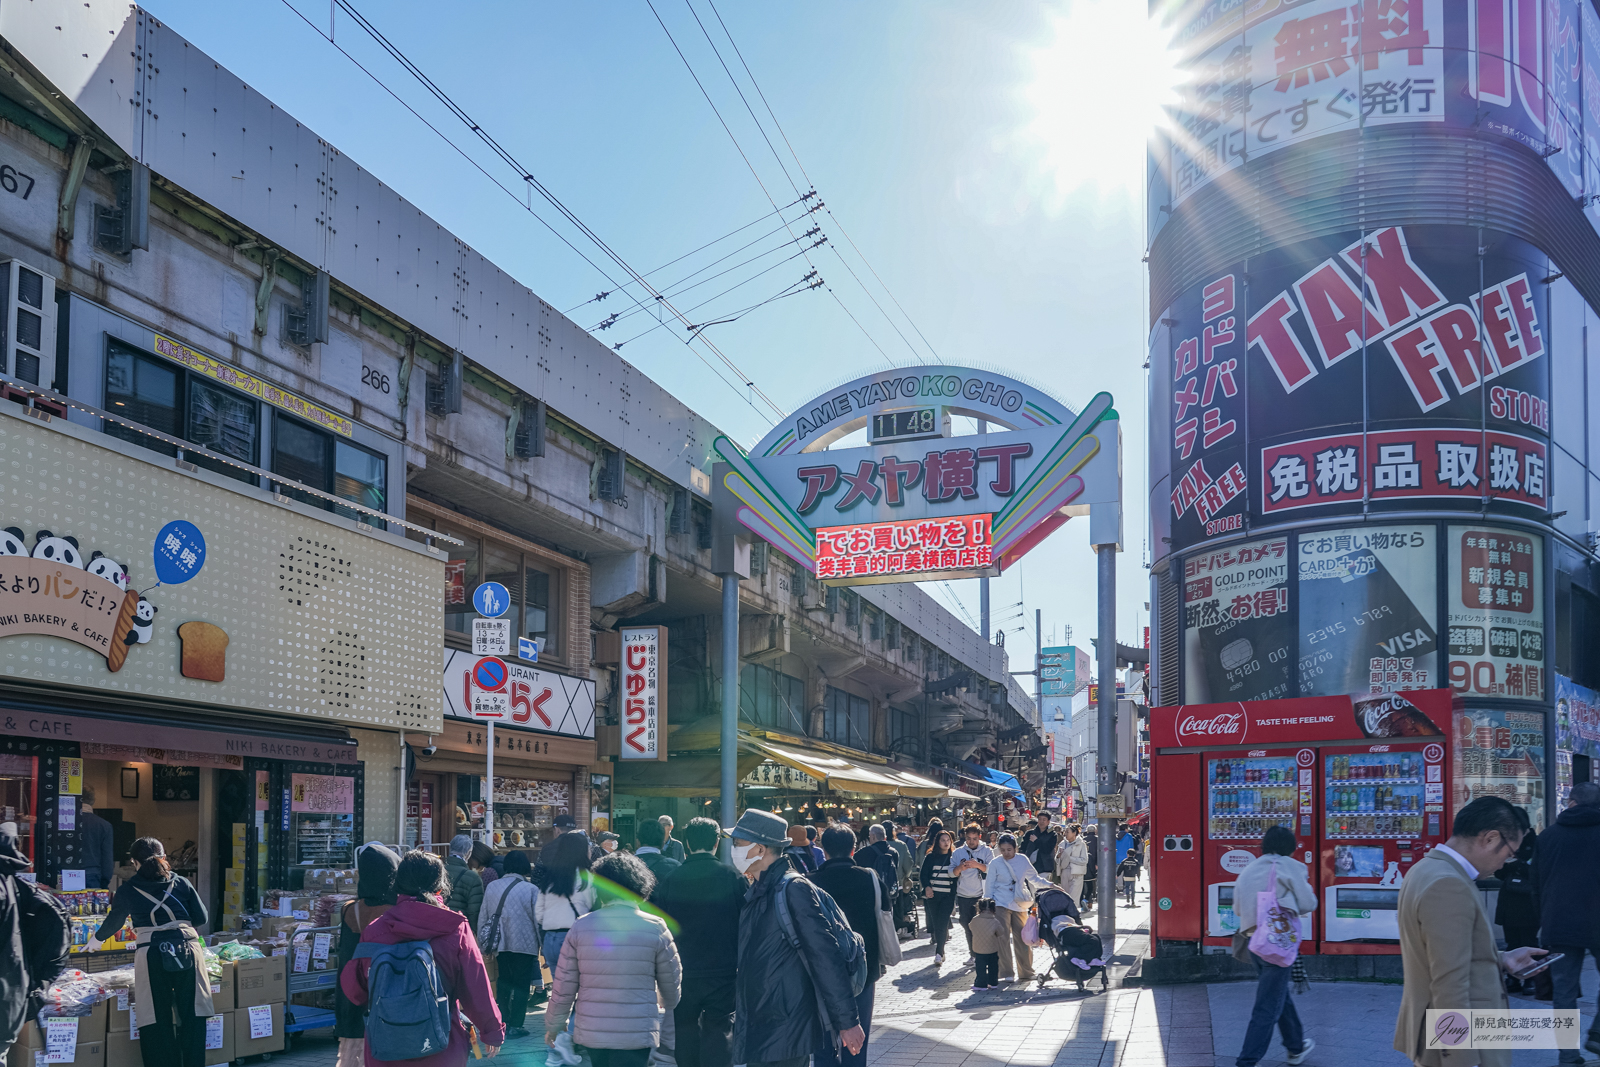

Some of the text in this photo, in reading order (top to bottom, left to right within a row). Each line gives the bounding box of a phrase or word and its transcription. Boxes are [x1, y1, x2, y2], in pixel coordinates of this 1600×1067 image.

[1273, 0, 1430, 93] 無料
[1248, 226, 1449, 394] TAX
[1383, 272, 1546, 413] FREE
[1201, 274, 1238, 449] ヨドバシ
[361, 364, 391, 394] 266
[796, 374, 1024, 440] AMEYAYOKOCHO
[1174, 337, 1199, 460] カメラ
[1489, 386, 1549, 432] STORE
[906, 409, 934, 433] 48
[796, 442, 1033, 514] アメヤ横丁
[1269, 440, 1546, 502] 免税品取扱店
[1171, 459, 1214, 519] TAX
[1194, 462, 1247, 526] FREE
[1206, 514, 1243, 536] STORE
[1185, 531, 1425, 578] ヨドバシカメラ でお買い物なら
[1466, 536, 1532, 555] 年会費・入会金
[1488, 550, 1511, 565] 無料
[1214, 571, 1245, 588] GOLD
[1248, 564, 1286, 581] POINT
[1299, 558, 1336, 573] CARD
[1468, 566, 1529, 589] 新規会員
[1192, 590, 1204, 600] より
[1478, 586, 1523, 607] 募集中
[24, 613, 67, 628] BAKERY
[71, 621, 79, 633] &
[84, 627, 109, 648] CAFE
[475, 622, 507, 630] 自転車を除く
[624, 634, 658, 642] レストラン
[1214, 621, 1237, 636] GOLD
[477, 644, 488, 652] 12
[1227, 659, 1261, 682] 4980
[1268, 646, 1289, 664] 00
[1307, 621, 1347, 645] 2345
[1352, 605, 1393, 626] 6789
[1377, 628, 1431, 656] VISA
[1449, 627, 1542, 652] 盗難 破損 水没
[1370, 657, 1414, 670] 店内で
[1459, 646, 1537, 659] から から から
[648, 644, 656, 689] 東京名物
[1299, 666, 1324, 683] ARO
[1370, 671, 1428, 684] 即時発行
[463, 669, 553, 729] らく
[474, 703, 506, 712] 貨物を除く
[625, 644, 647, 754] じゅらく
[5, 716, 74, 736] & CAFE
[1179, 713, 1243, 736] Coca-Cola
[1299, 716, 1334, 724] FEELING
[226, 739, 353, 760] NIKI BAKERY & CAFE
[422, 807, 430, 815] xit
